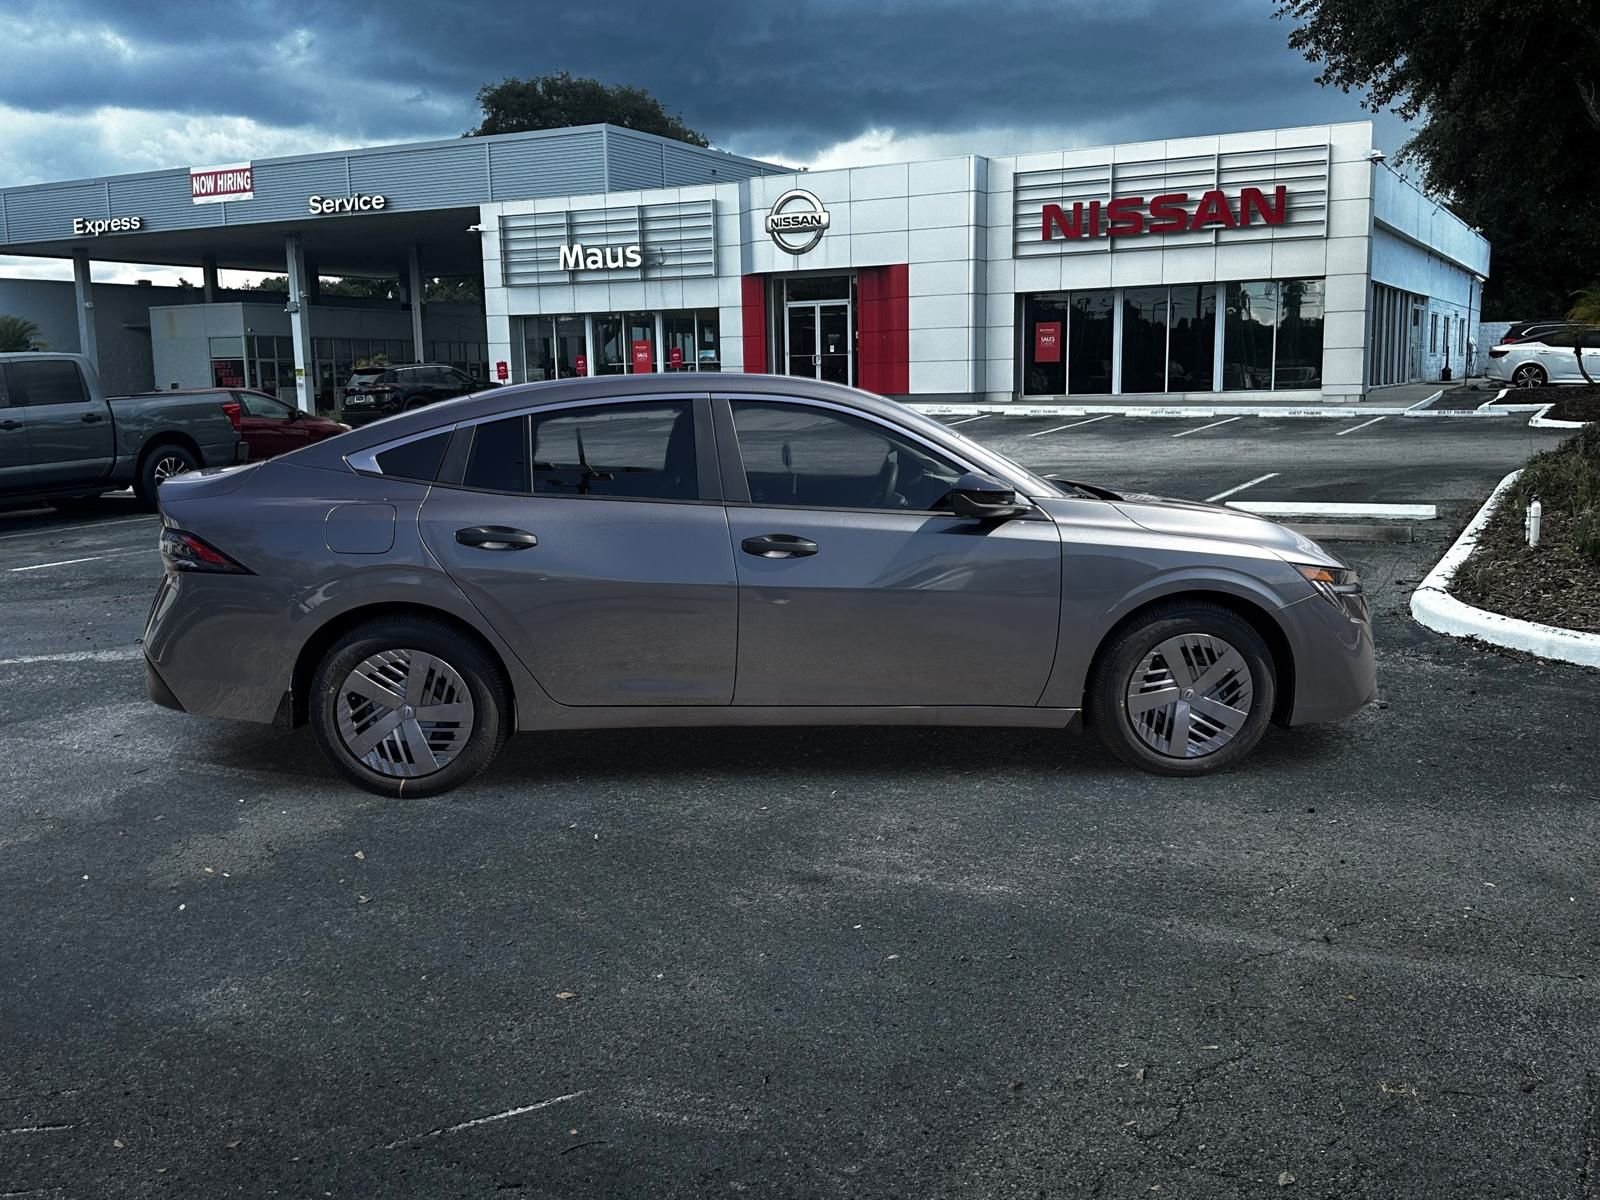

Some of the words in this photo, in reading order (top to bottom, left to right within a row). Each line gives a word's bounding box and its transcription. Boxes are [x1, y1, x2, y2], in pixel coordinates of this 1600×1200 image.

[192, 173, 215, 195] NOW
[217, 171, 251, 193] HIRING
[309, 193, 385, 214] Service
[1042, 185, 1287, 241] NISSAN
[73, 216, 141, 236] Express
[770, 214, 822, 229] NISSAN
[559, 243, 642, 271] Maus
